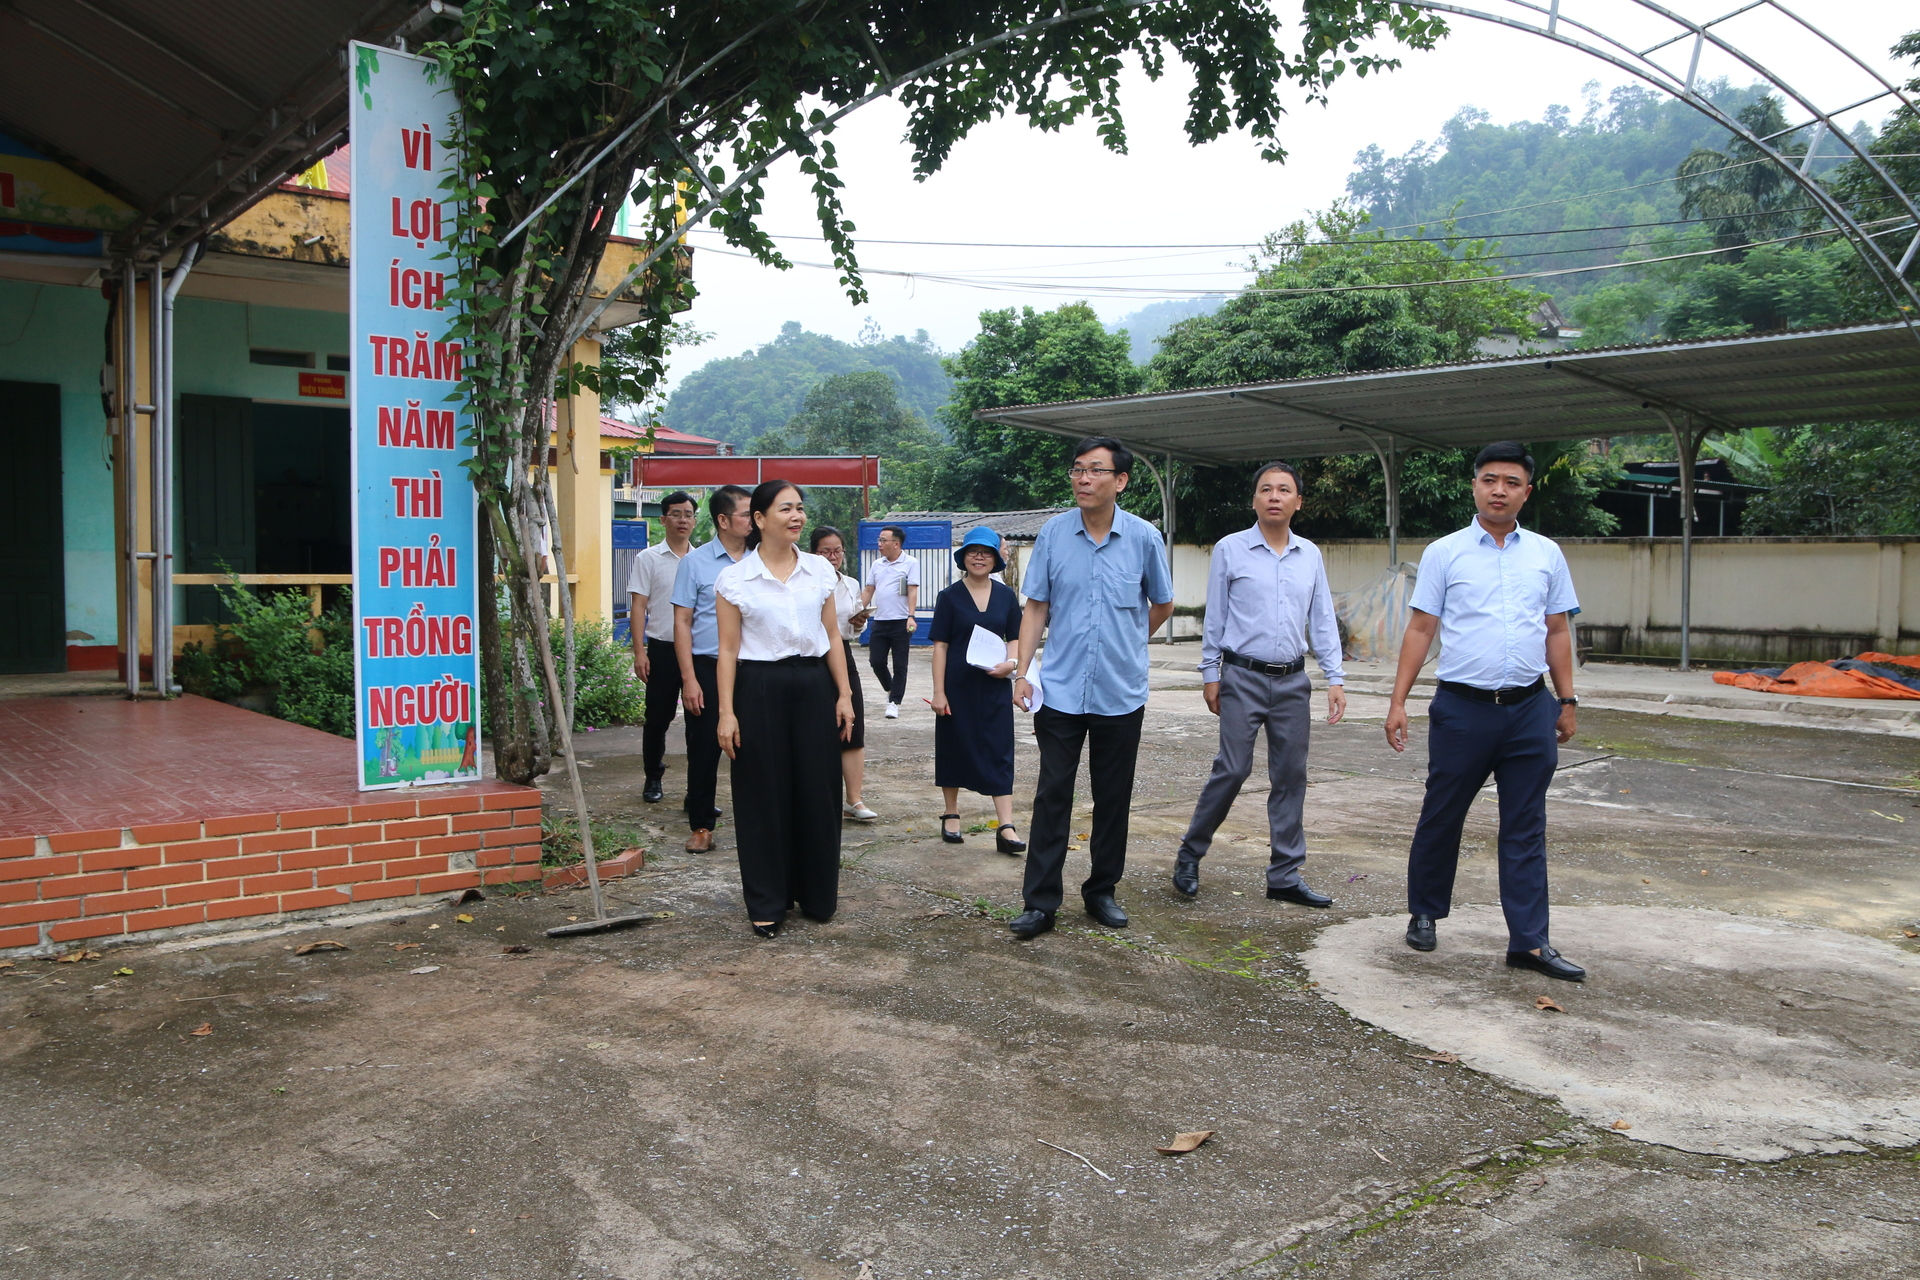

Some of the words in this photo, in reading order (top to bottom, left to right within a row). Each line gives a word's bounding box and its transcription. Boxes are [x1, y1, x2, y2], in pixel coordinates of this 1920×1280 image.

[401, 123, 432, 171] VÌ
[391, 198, 442, 249] LỢI
[389, 258, 444, 311] ÍCH
[369, 331, 463, 381] TRĂM
[379, 400, 455, 449] NĂM
[392, 470, 443, 518] THÌ
[379, 534, 456, 587] PHẢI
[363, 602, 472, 657] TRỒNG
[369, 674, 470, 727] NGƯỜI
